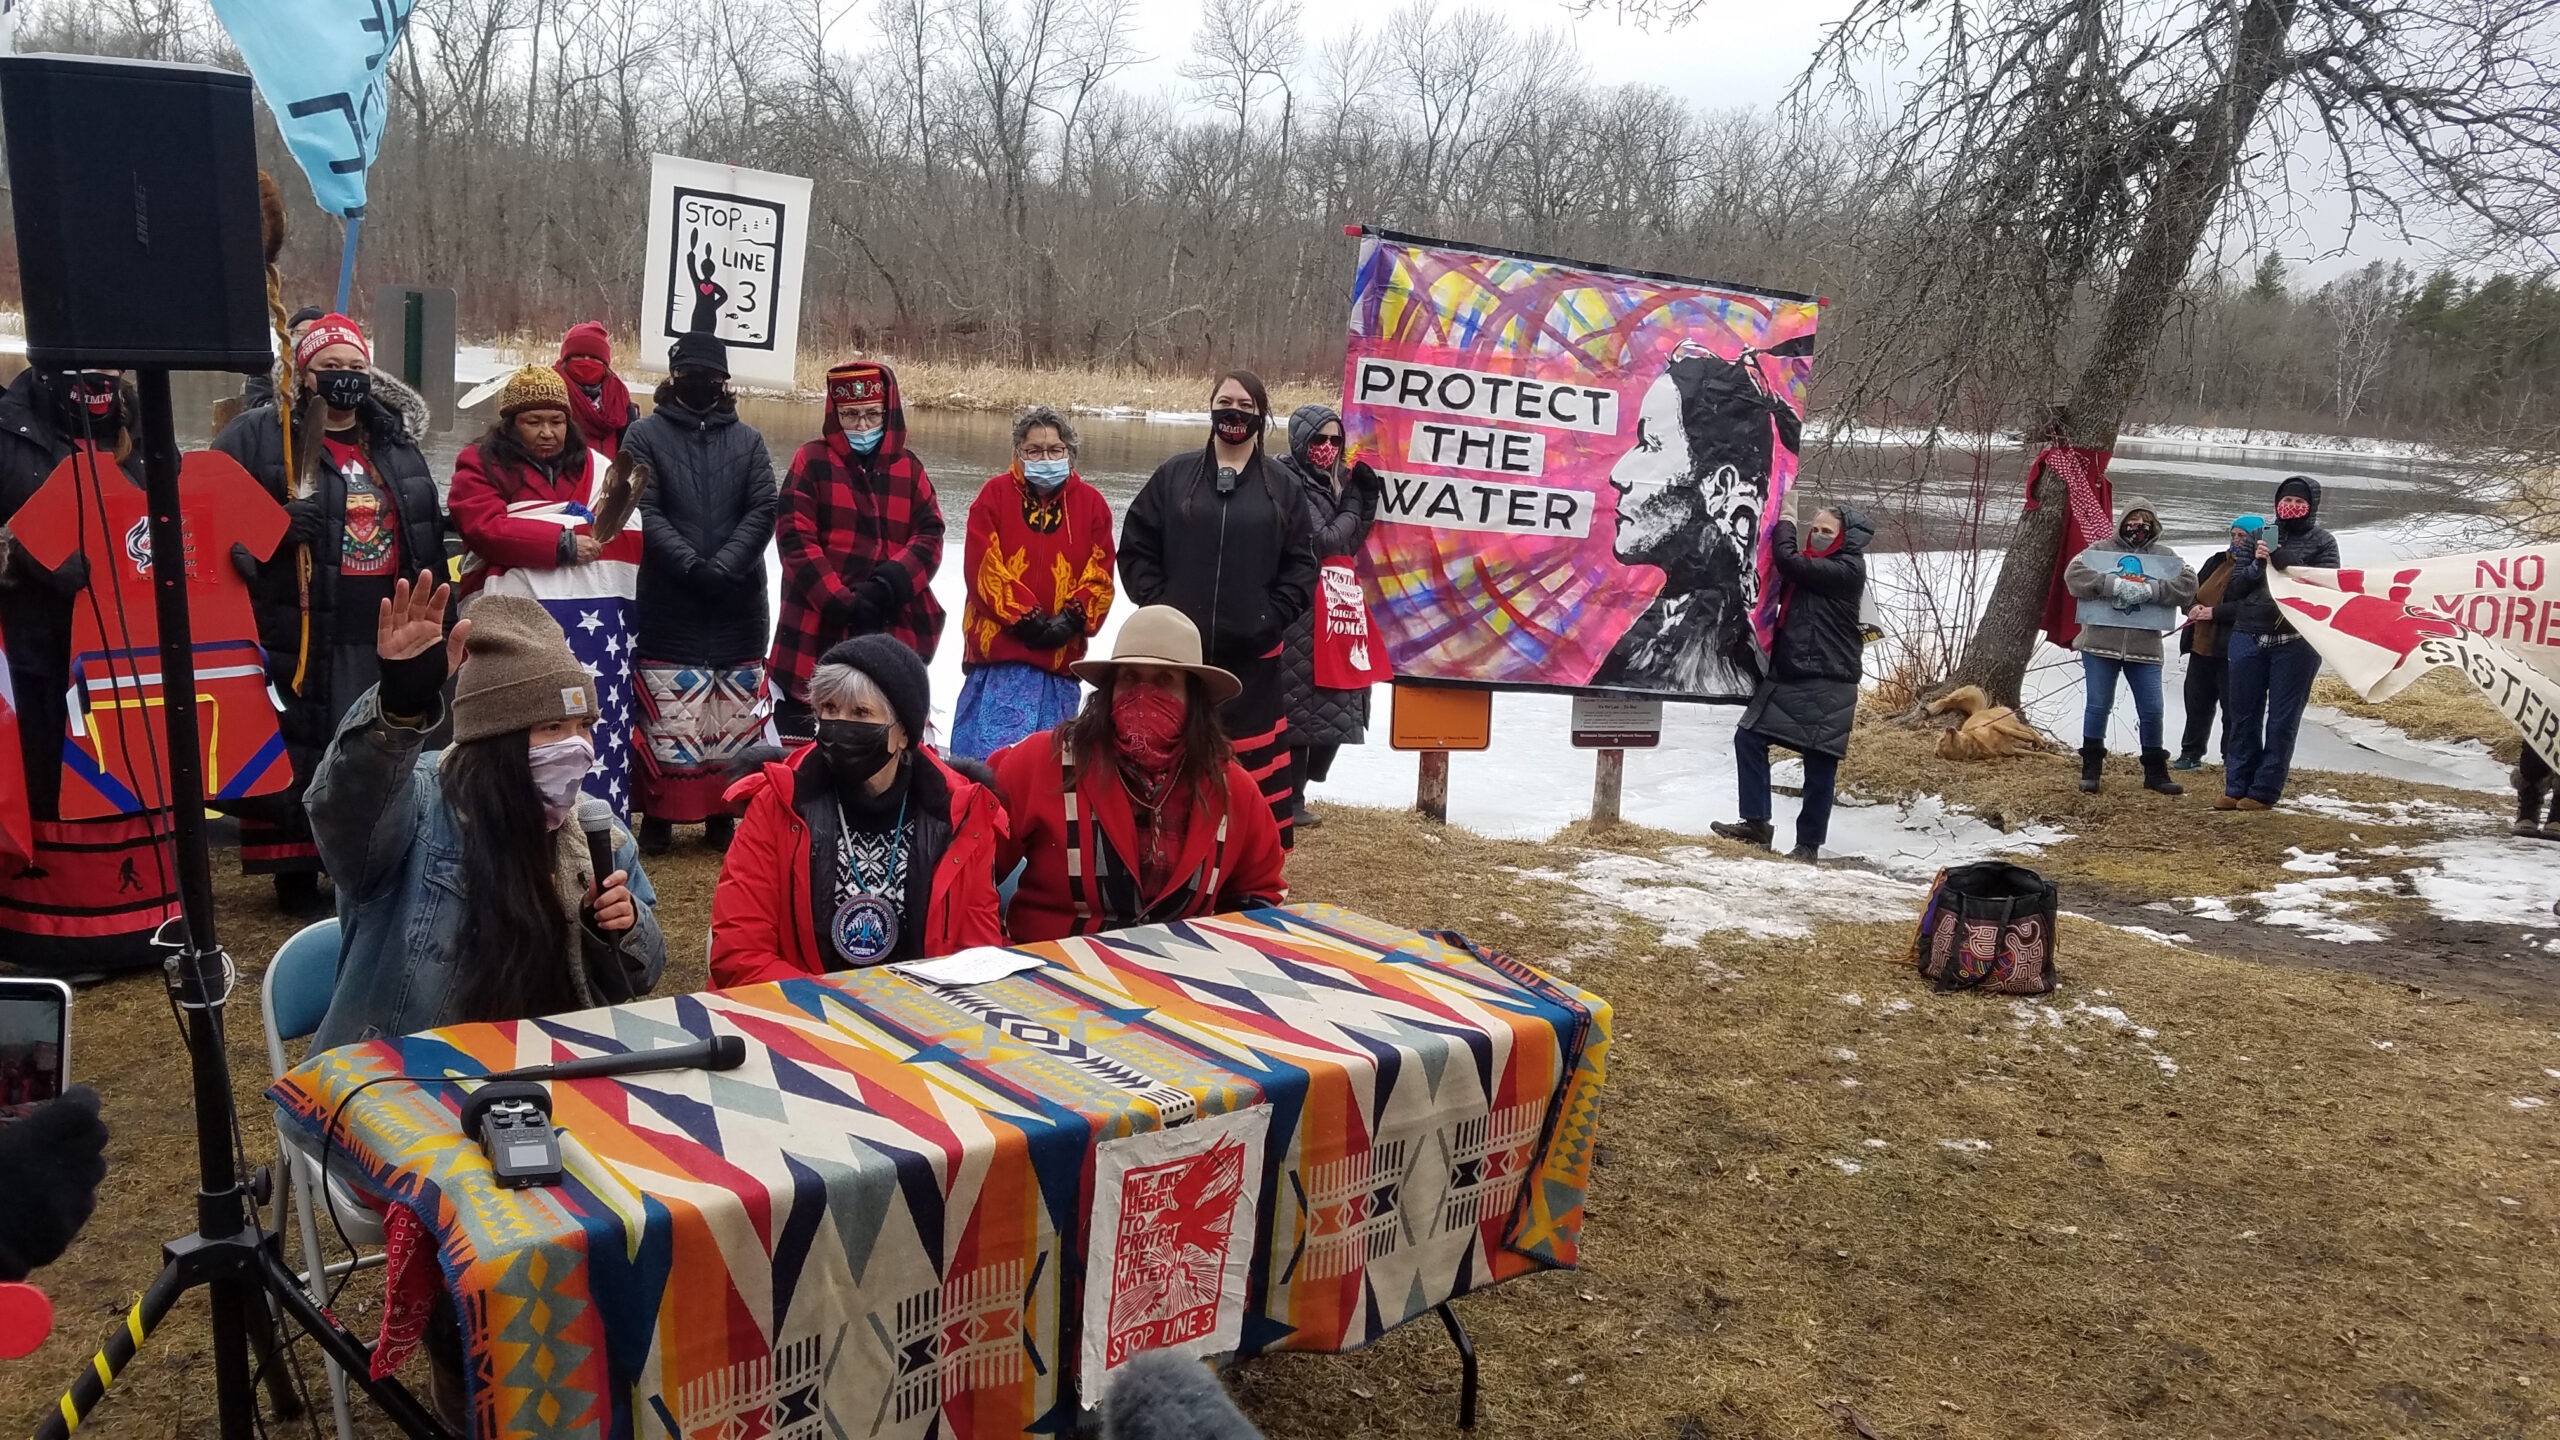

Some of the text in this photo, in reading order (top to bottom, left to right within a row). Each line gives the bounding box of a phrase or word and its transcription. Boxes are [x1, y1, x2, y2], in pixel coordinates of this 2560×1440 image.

[686, 201, 742, 231] STOP
[722, 247, 766, 272] LINE
[736, 281, 756, 312] 3
[302, 335, 330, 359] PROTECT
[333, 378, 359, 389] NO
[1360, 364, 1611, 425] PROTECT
[1423, 425, 1532, 472] THE
[1377, 475, 1578, 530] WATER
[1325, 571, 1355, 586] JUSTI
[2475, 555, 2545, 592] NO
[1126, 1168, 1184, 1198] WE ARE
[1126, 1192, 1168, 1215] HERE
[1119, 1222, 1182, 1253] PROTECT
[1124, 1214, 1147, 1235] TO
[1118, 1251, 1149, 1274] THE
[1117, 1262, 1168, 1294] WATER
[1110, 1307, 1215, 1363] STOP LINE 3
